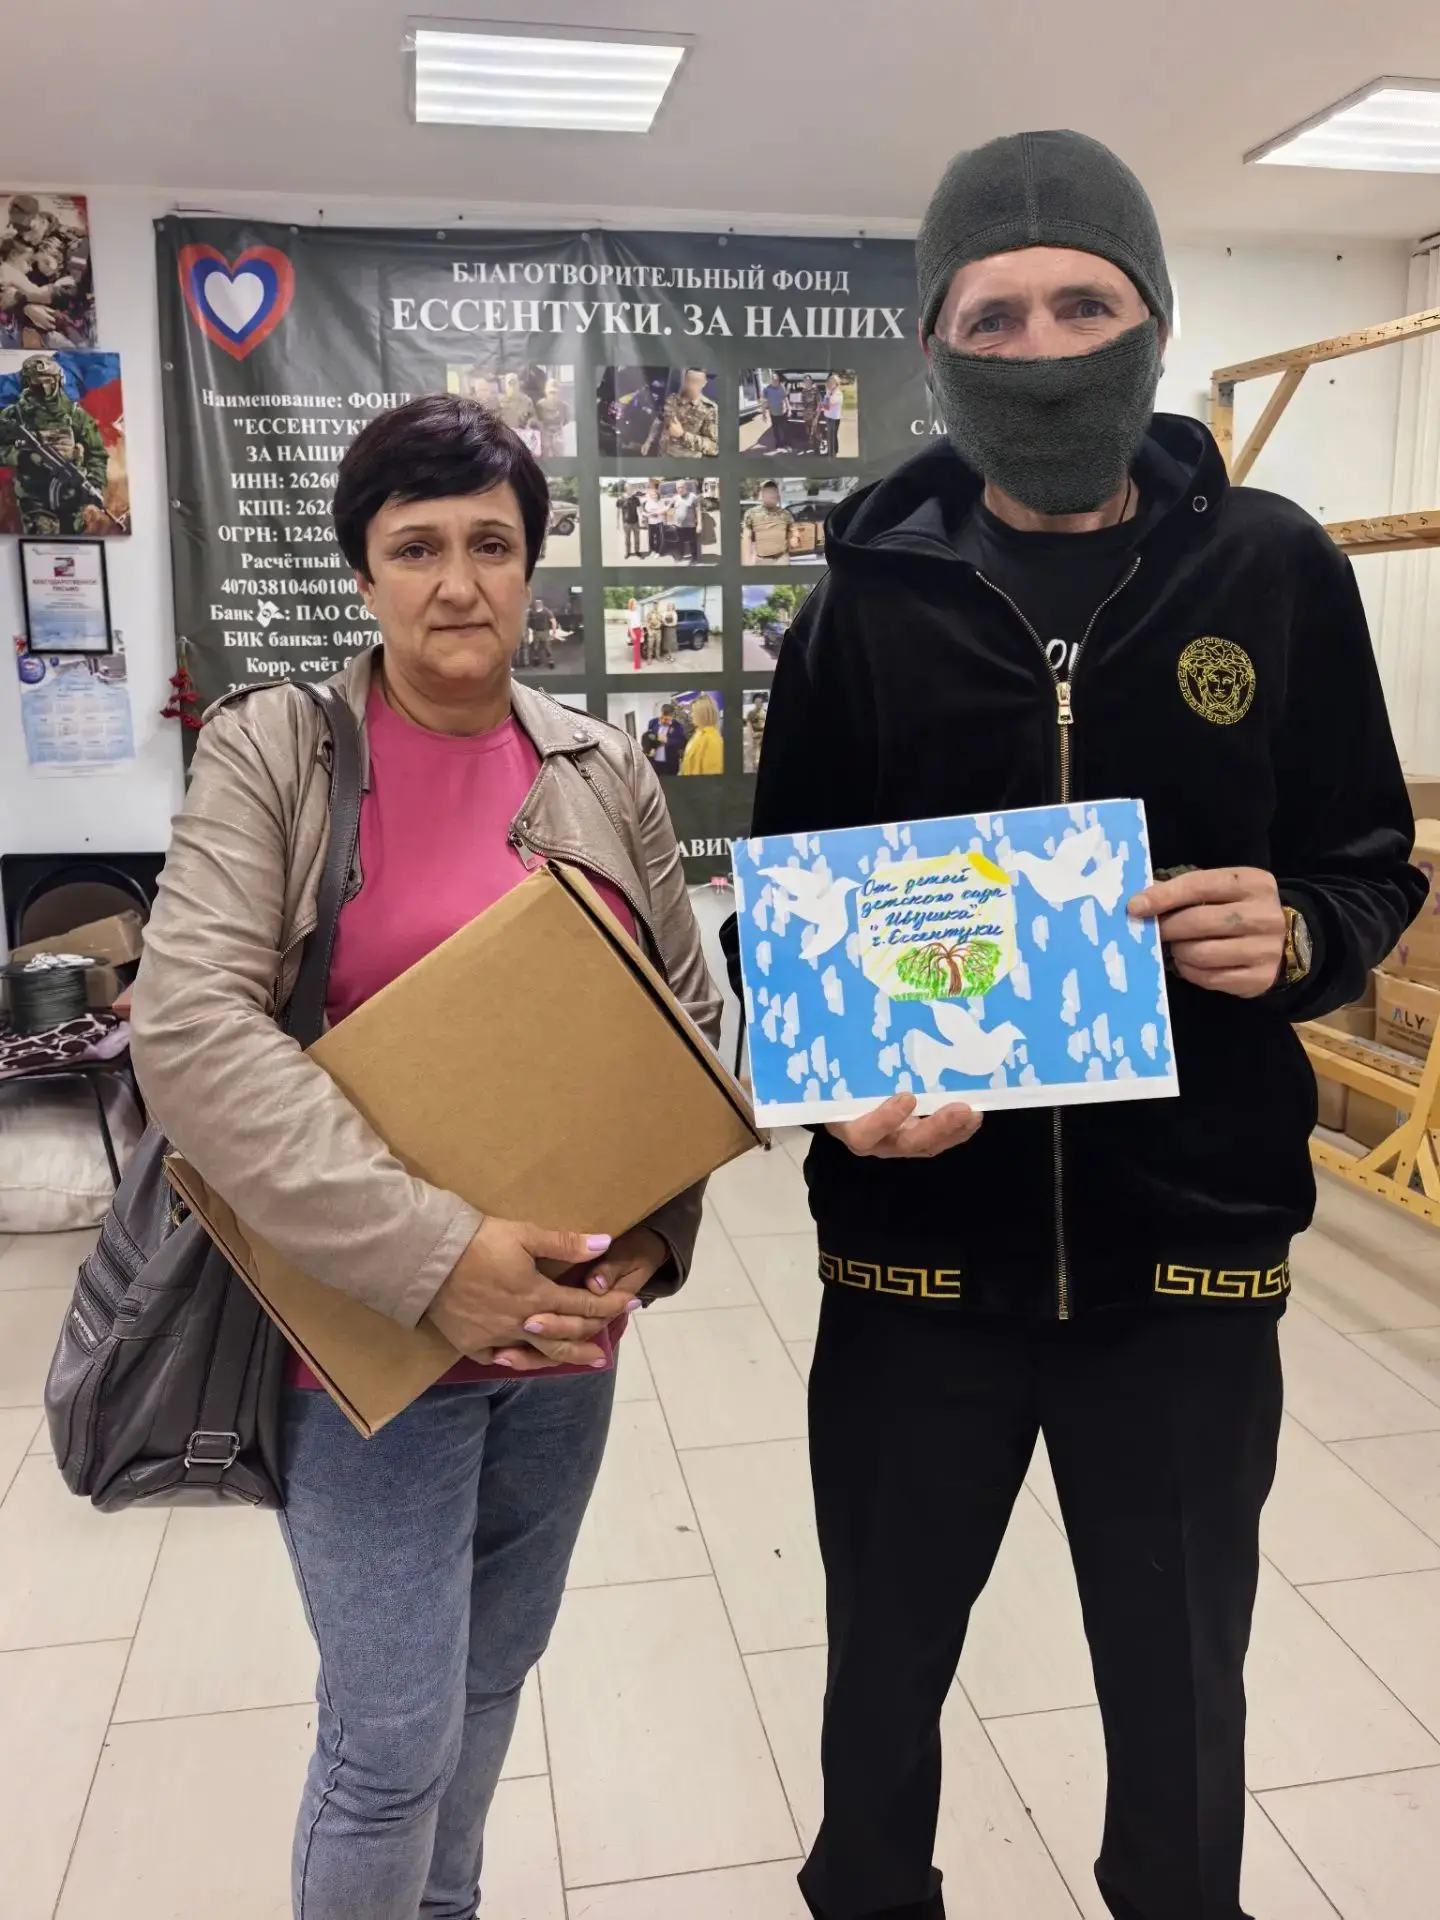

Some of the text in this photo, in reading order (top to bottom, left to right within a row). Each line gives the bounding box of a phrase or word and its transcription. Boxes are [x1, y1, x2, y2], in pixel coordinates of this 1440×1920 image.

[452, 262, 850, 296] БЛАГОТВОРИТЕЛЬНЫЙ ФОНД
[391, 298, 905, 339] ЕССЕНТУКИ. ЗА НАШИХ
[202, 388, 342, 408] Наименование:
[246, 445, 350, 462] ЗА НАШИ
[231, 473, 284, 489] ИНН:
[238, 500, 291, 516] КПП:
[218, 525, 338, 543] ОГРН: 12426
[241, 553, 340, 569] Расчётный
[296, 605, 340, 621] ПАО
[224, 631, 264, 647] БИК
[268, 631, 328, 647] банка:
[246, 657, 295, 677] Корр.
[300, 656, 339, 672] счёт
[863, 868, 972, 896] От детей
[862, 893, 954, 918] детского
